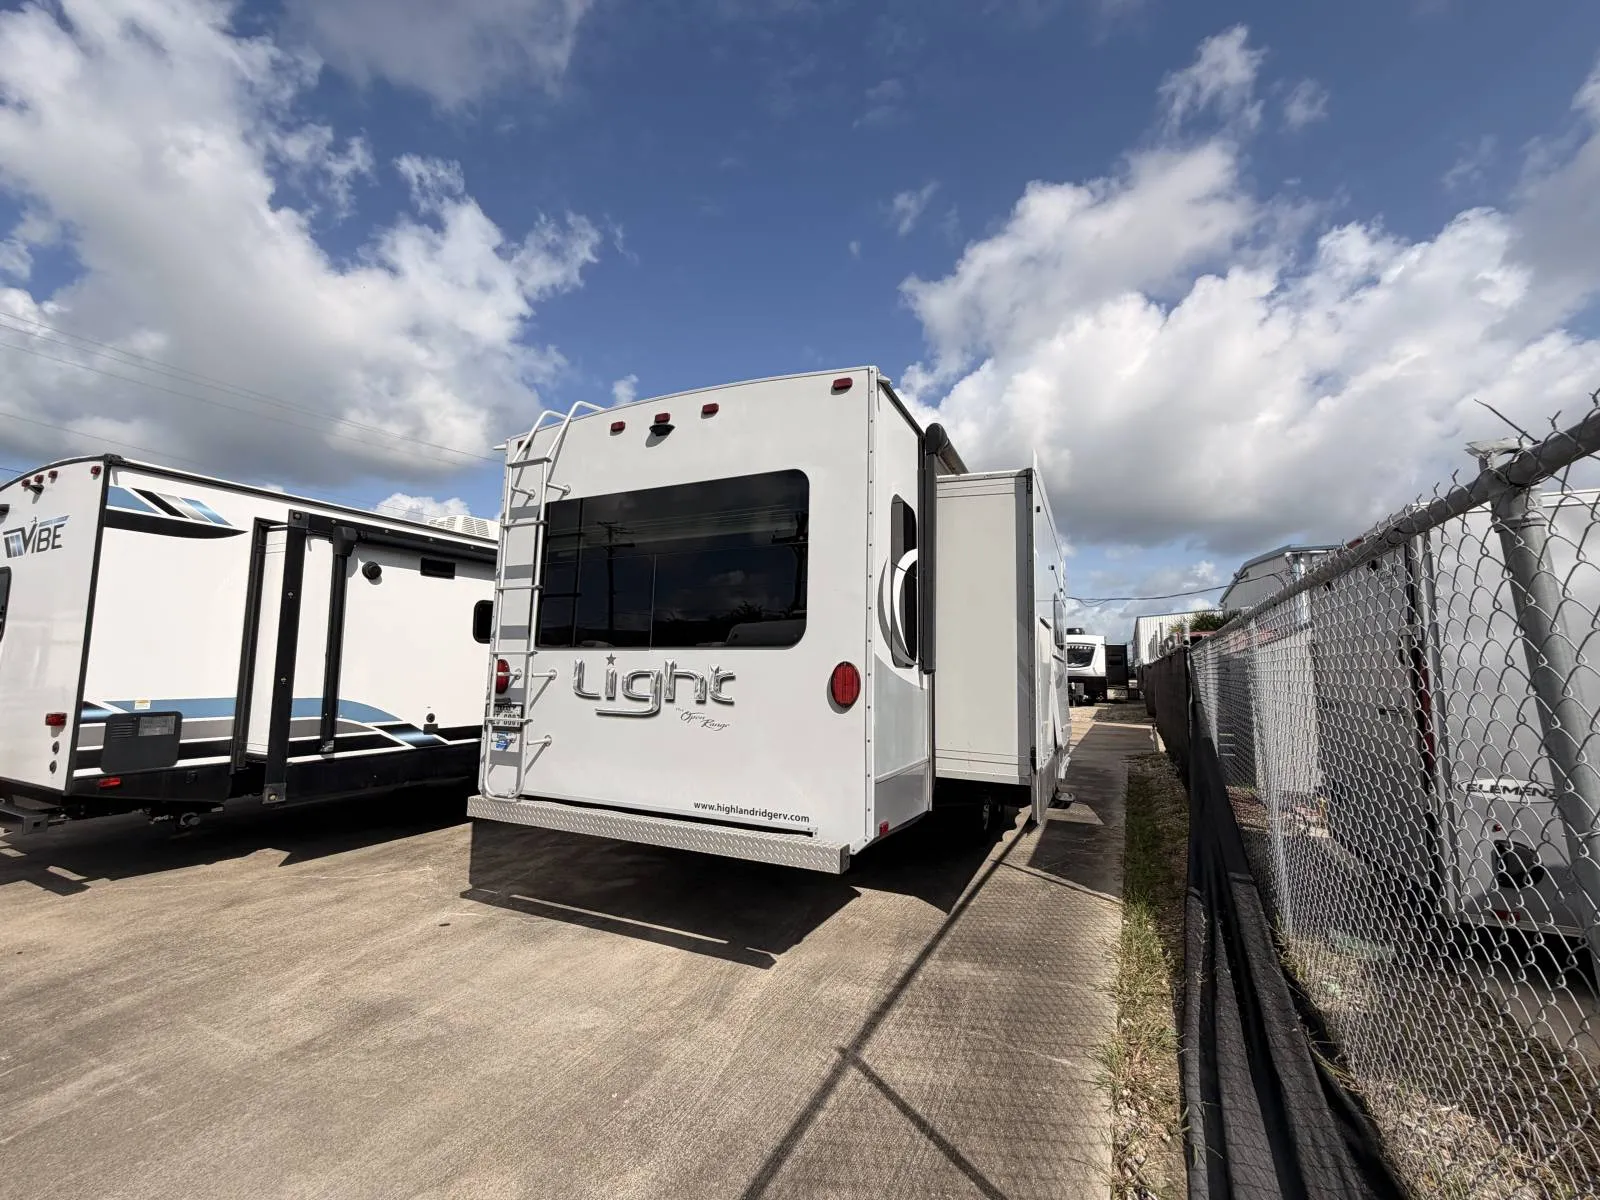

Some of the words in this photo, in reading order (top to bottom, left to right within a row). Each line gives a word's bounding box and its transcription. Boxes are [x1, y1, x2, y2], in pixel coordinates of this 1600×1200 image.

[3, 522, 66, 558] VIBE
[572, 652, 736, 718] Light
[680, 711, 705, 724] Open
[700, 719, 730, 731] Range
[693, 801, 811, 823] www.highlandridgerv.com
